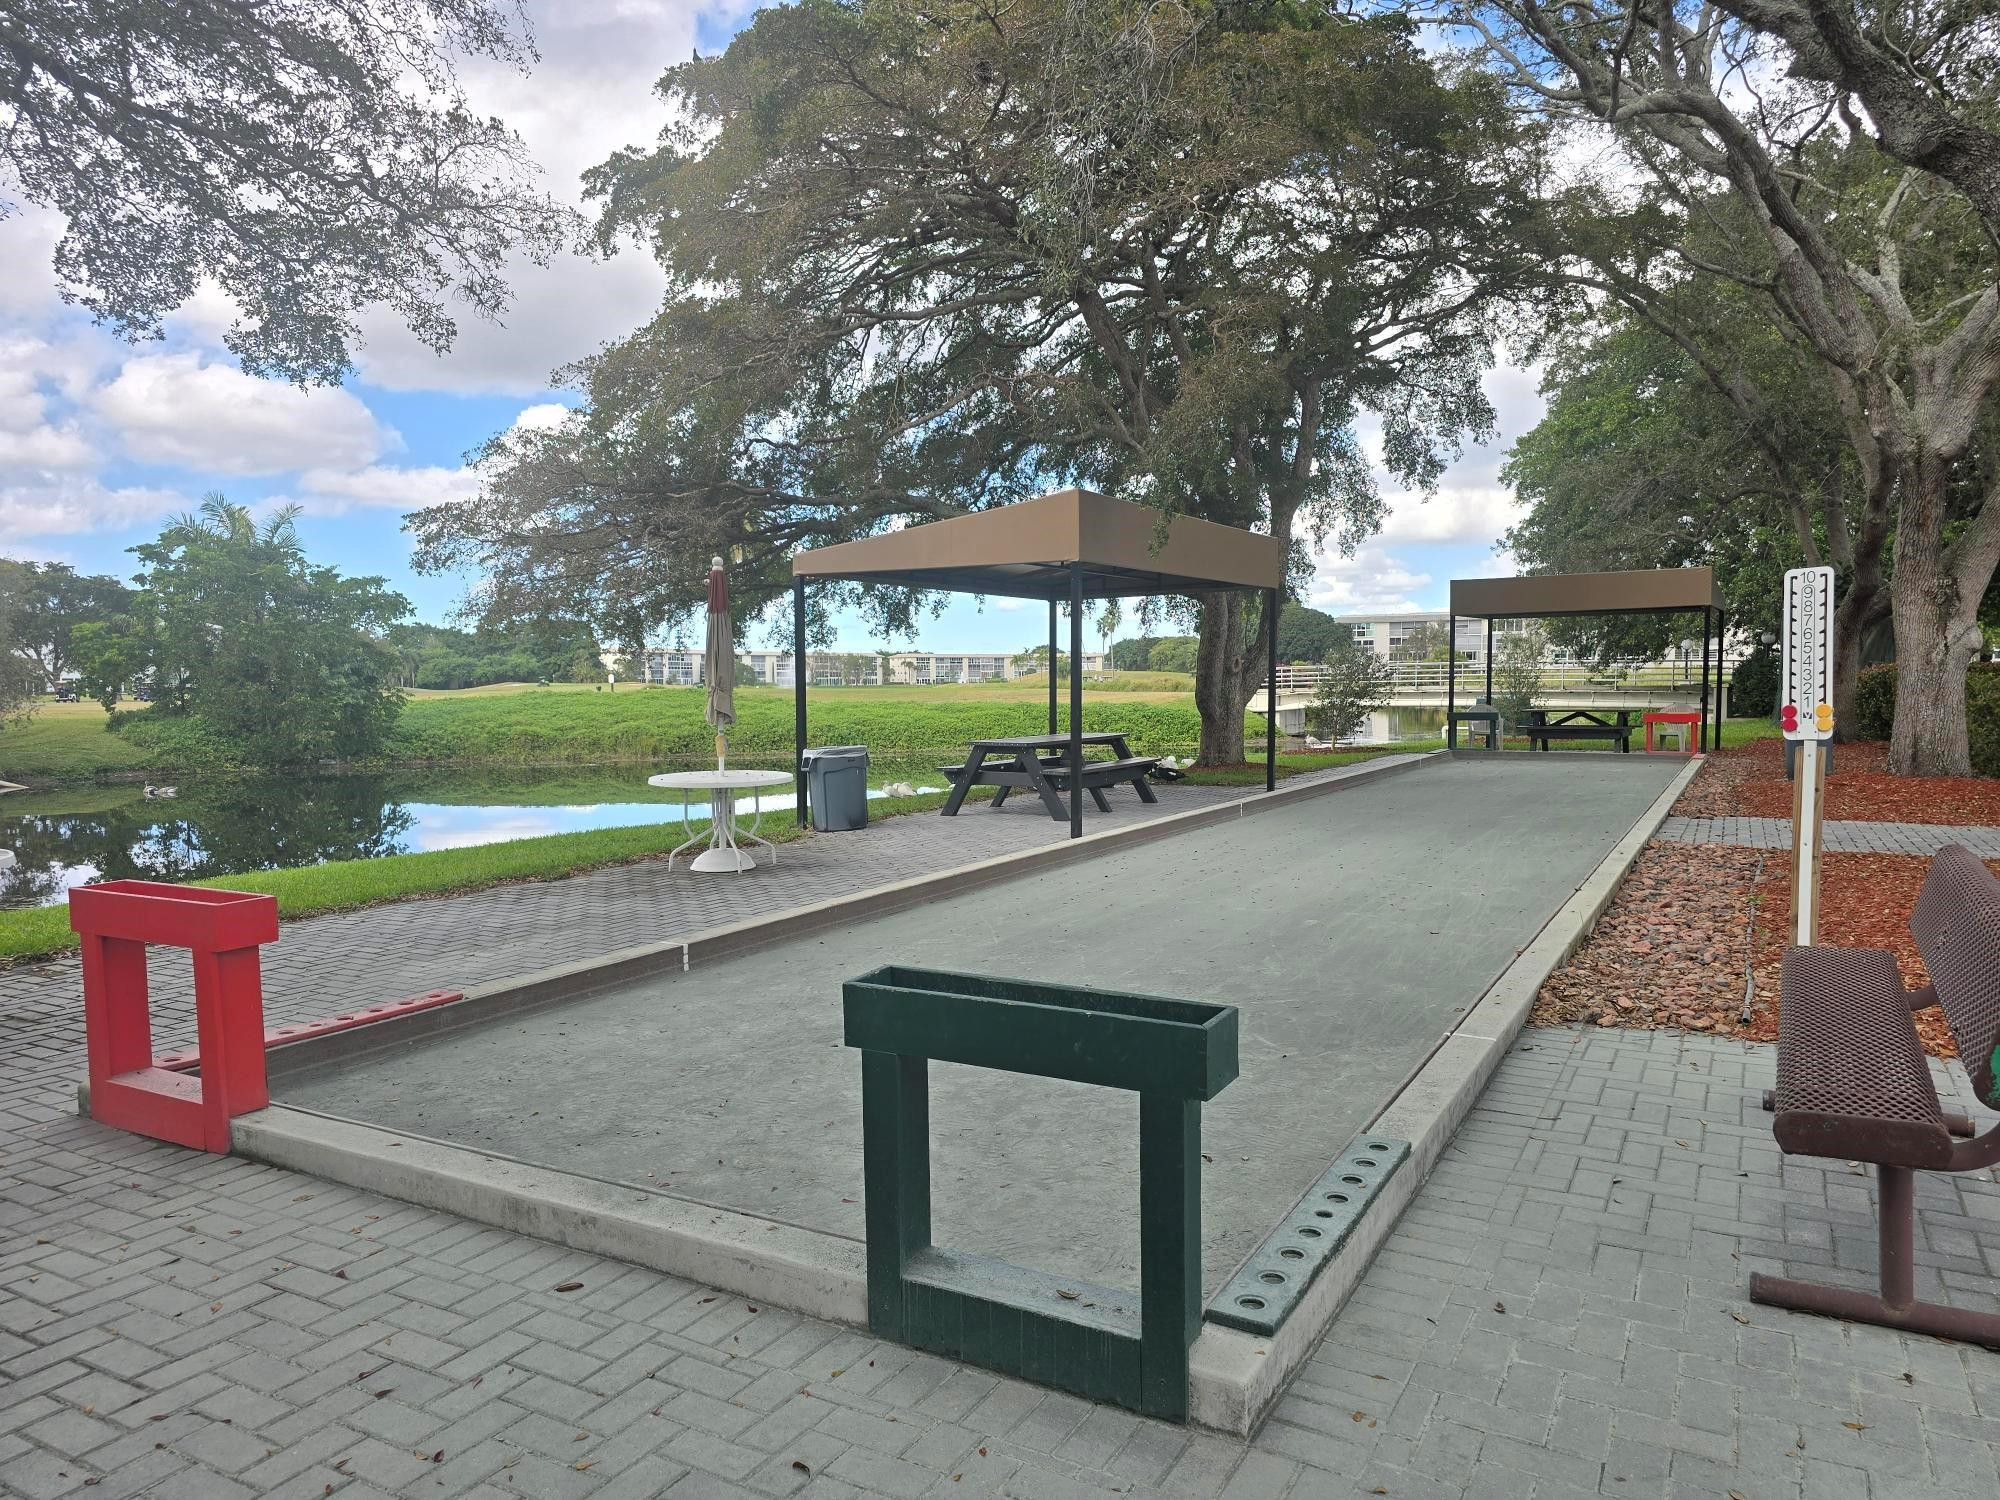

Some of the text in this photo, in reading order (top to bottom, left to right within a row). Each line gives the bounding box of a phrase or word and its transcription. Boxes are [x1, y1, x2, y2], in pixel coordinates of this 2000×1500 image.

[1800, 571, 1816, 583] 10
[1803, 586, 1813, 599] 9
[1803, 600, 1813, 612] 8
[1803, 614, 1813, 626] 7
[1803, 628, 1812, 640] 6
[1803, 642, 1812, 654] 5
[1803, 655, 1812, 667] 4
[1803, 669, 1812, 681] 3
[1803, 682, 1812, 695] 2
[1803, 696, 1810, 708] 1
